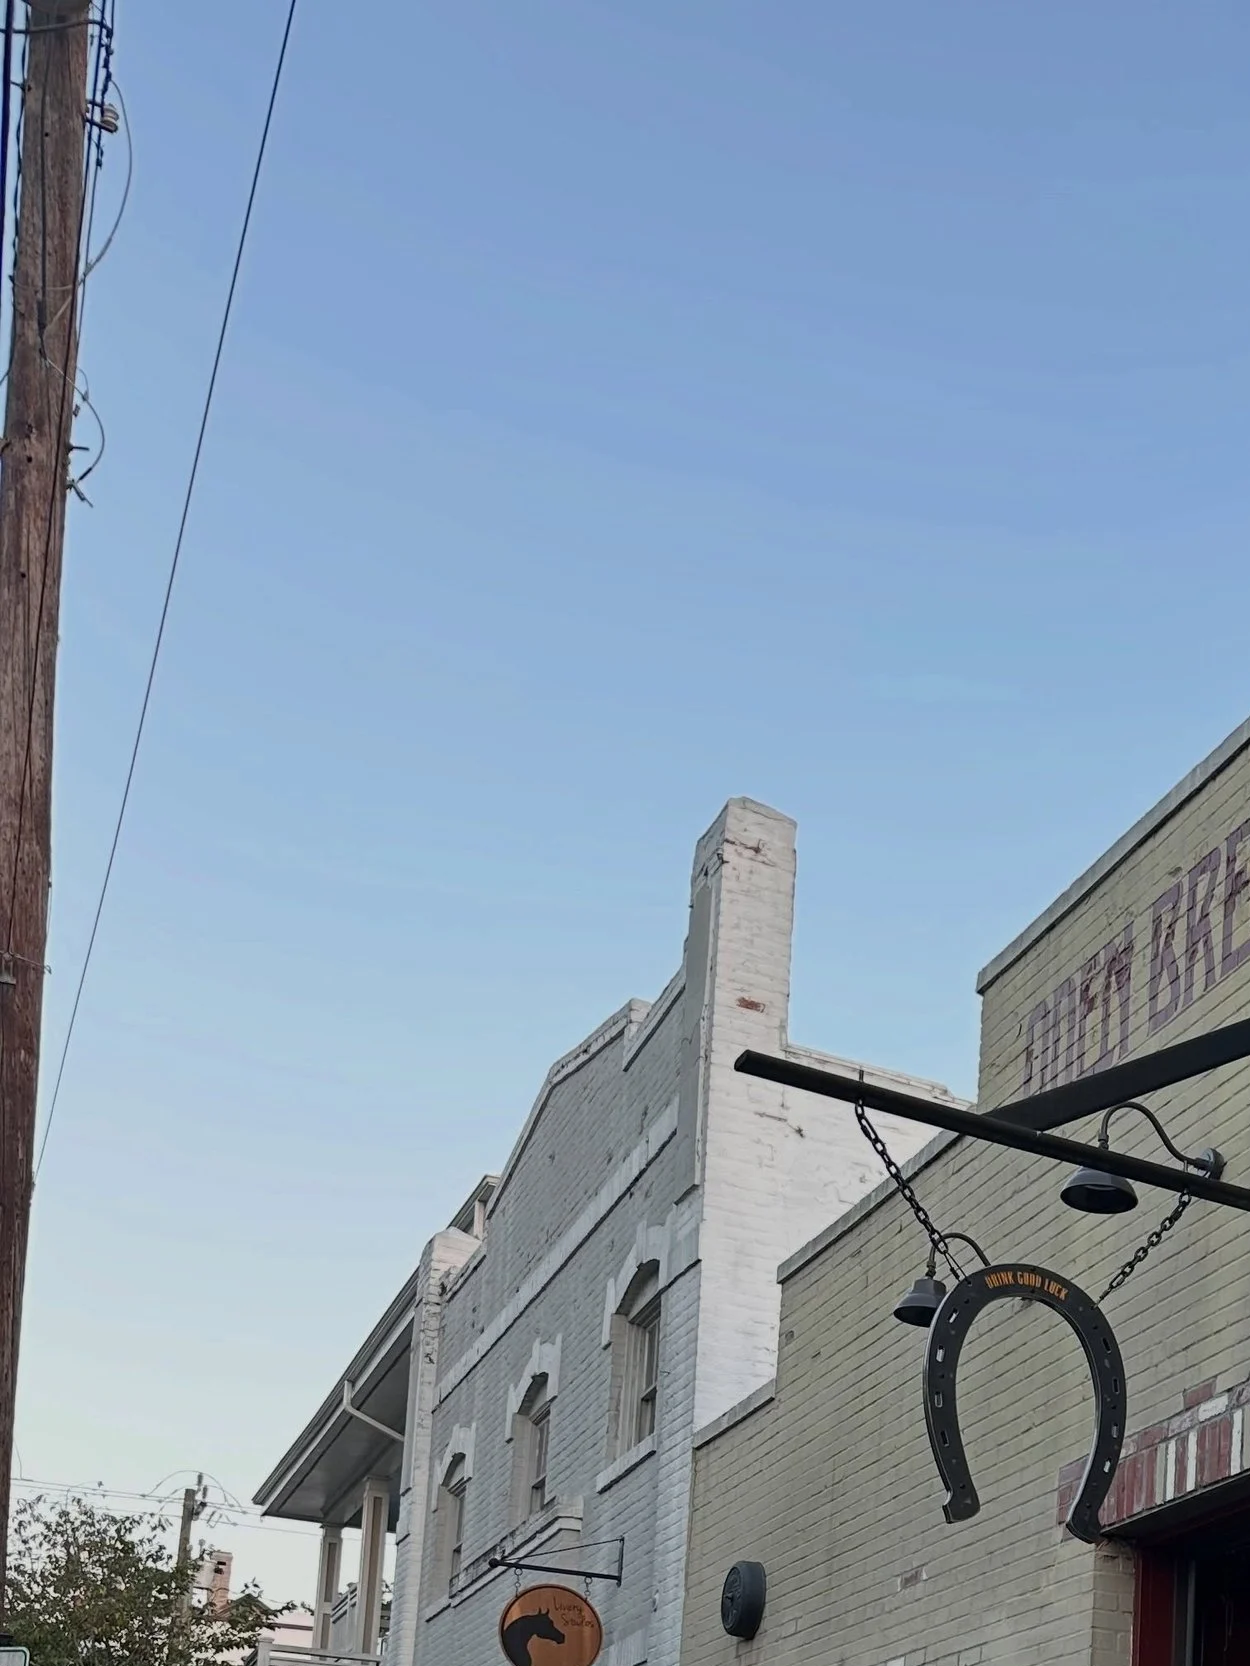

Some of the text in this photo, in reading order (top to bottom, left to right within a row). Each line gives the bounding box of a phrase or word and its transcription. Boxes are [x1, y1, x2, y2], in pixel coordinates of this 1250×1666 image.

[984, 1271, 1069, 1300] DRINK GOOD LUCK
